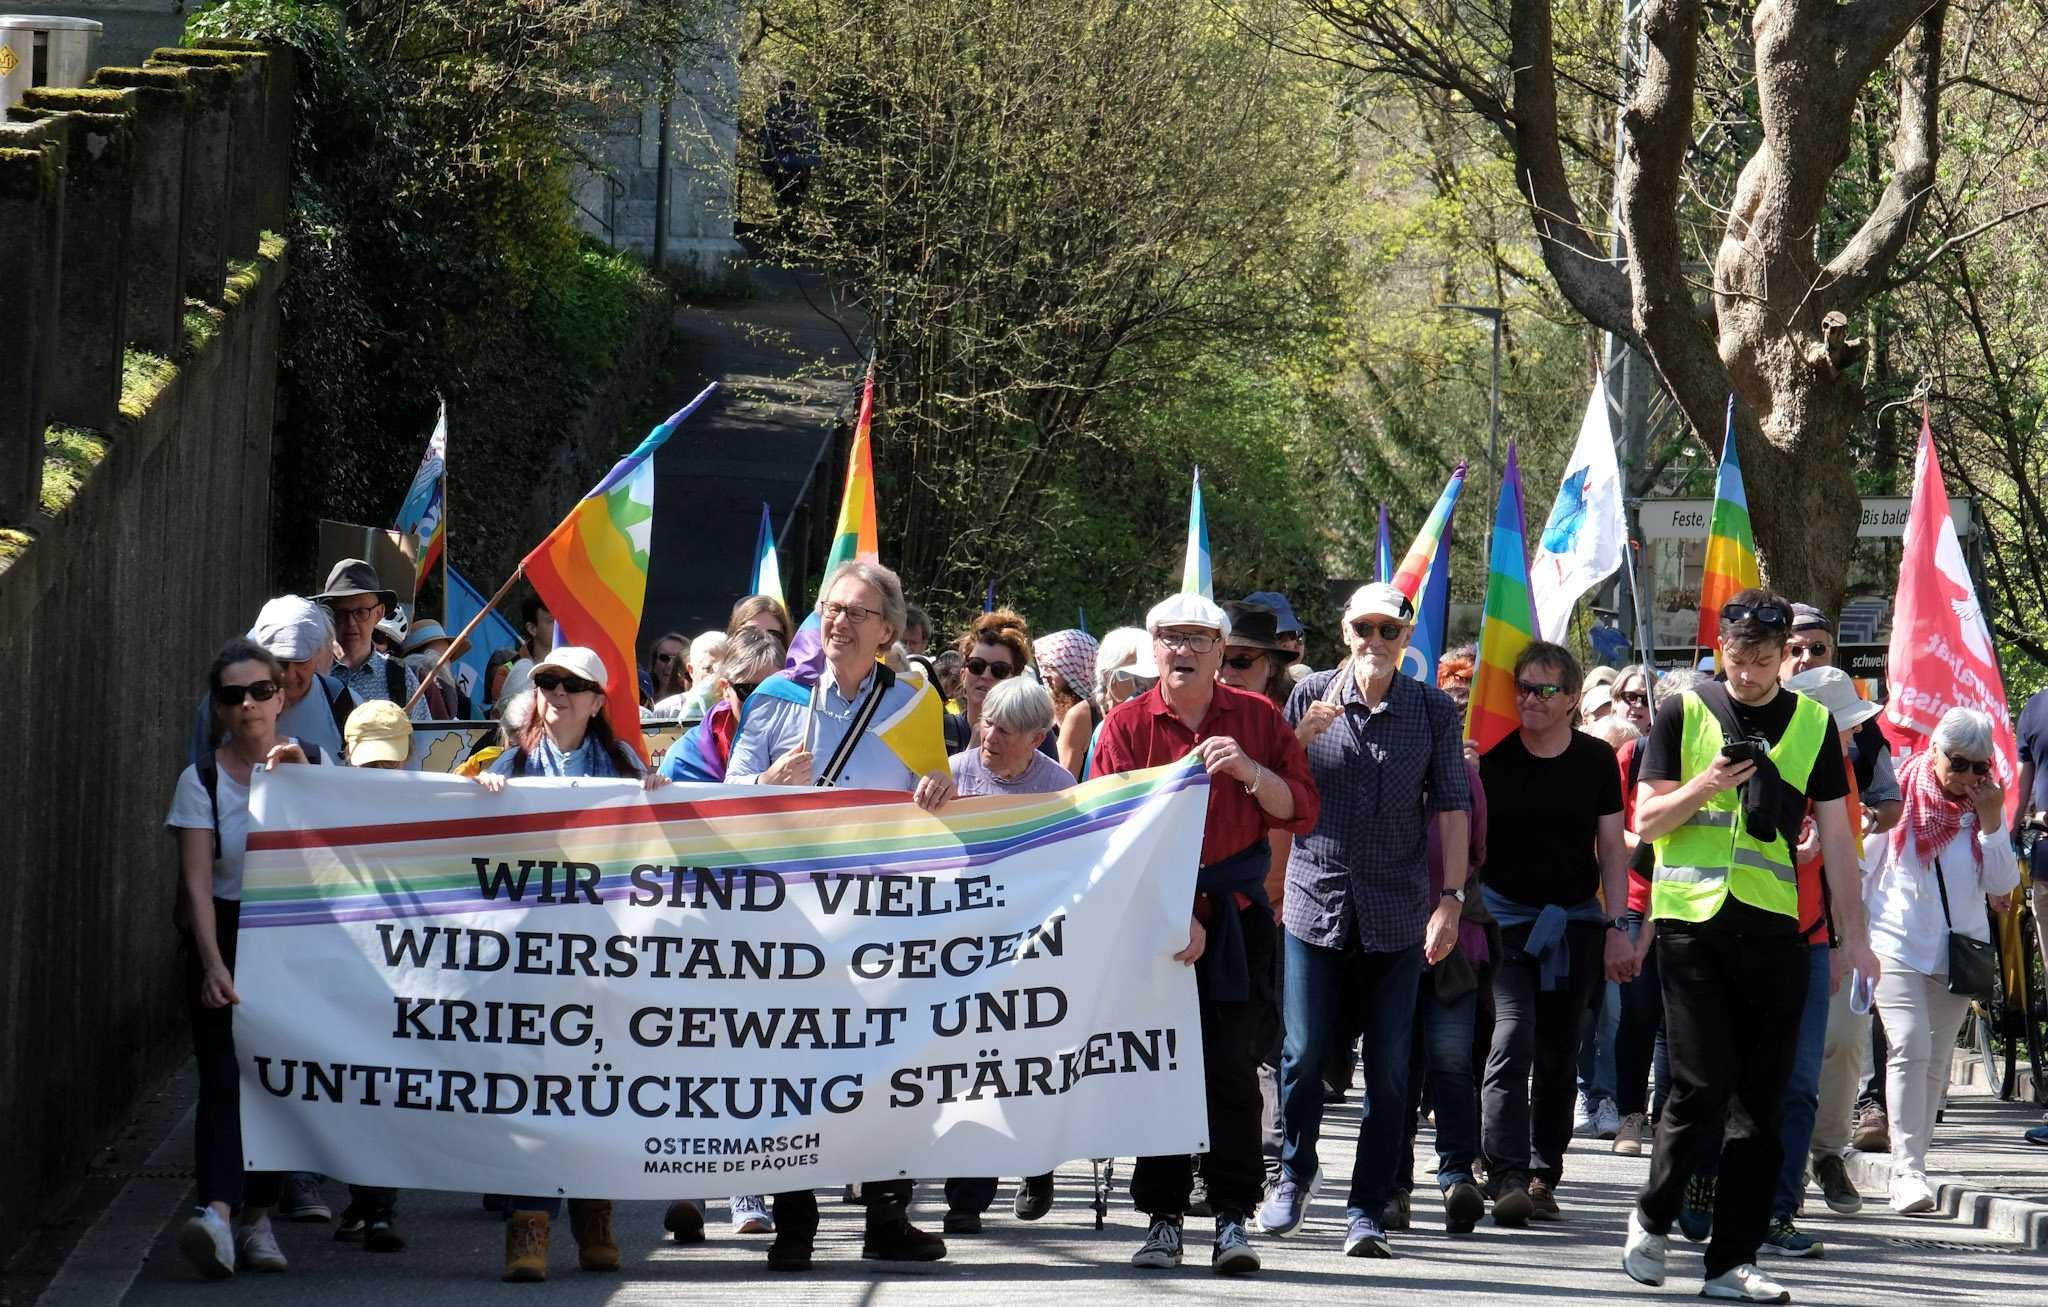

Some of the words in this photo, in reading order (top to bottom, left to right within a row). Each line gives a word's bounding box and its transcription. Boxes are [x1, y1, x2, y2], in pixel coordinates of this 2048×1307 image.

[1672, 511, 1706, 528] Feste,
[1862, 510, 1880, 525] Bis
[472, 857, 604, 906] WIR
[629, 864, 786, 912] SIND
[809, 872, 1006, 917] VIELE:
[376, 924, 827, 981] WIDERSTAND
[851, 914, 1066, 980] GEGEN
[393, 996, 604, 1055] KRIEG,
[629, 1006, 907, 1050] GEWALT
[930, 986, 1069, 1038] UND
[255, 1056, 865, 1120] UNTERDRÜCKUNG
[890, 1028, 1178, 1110] STÄRKEN!
[644, 1132, 820, 1155] OSTERMARSCH
[644, 1160, 718, 1174] MARCHE
[723, 1160, 745, 1173] DE
[751, 1153, 819, 1171] PÂQUES
